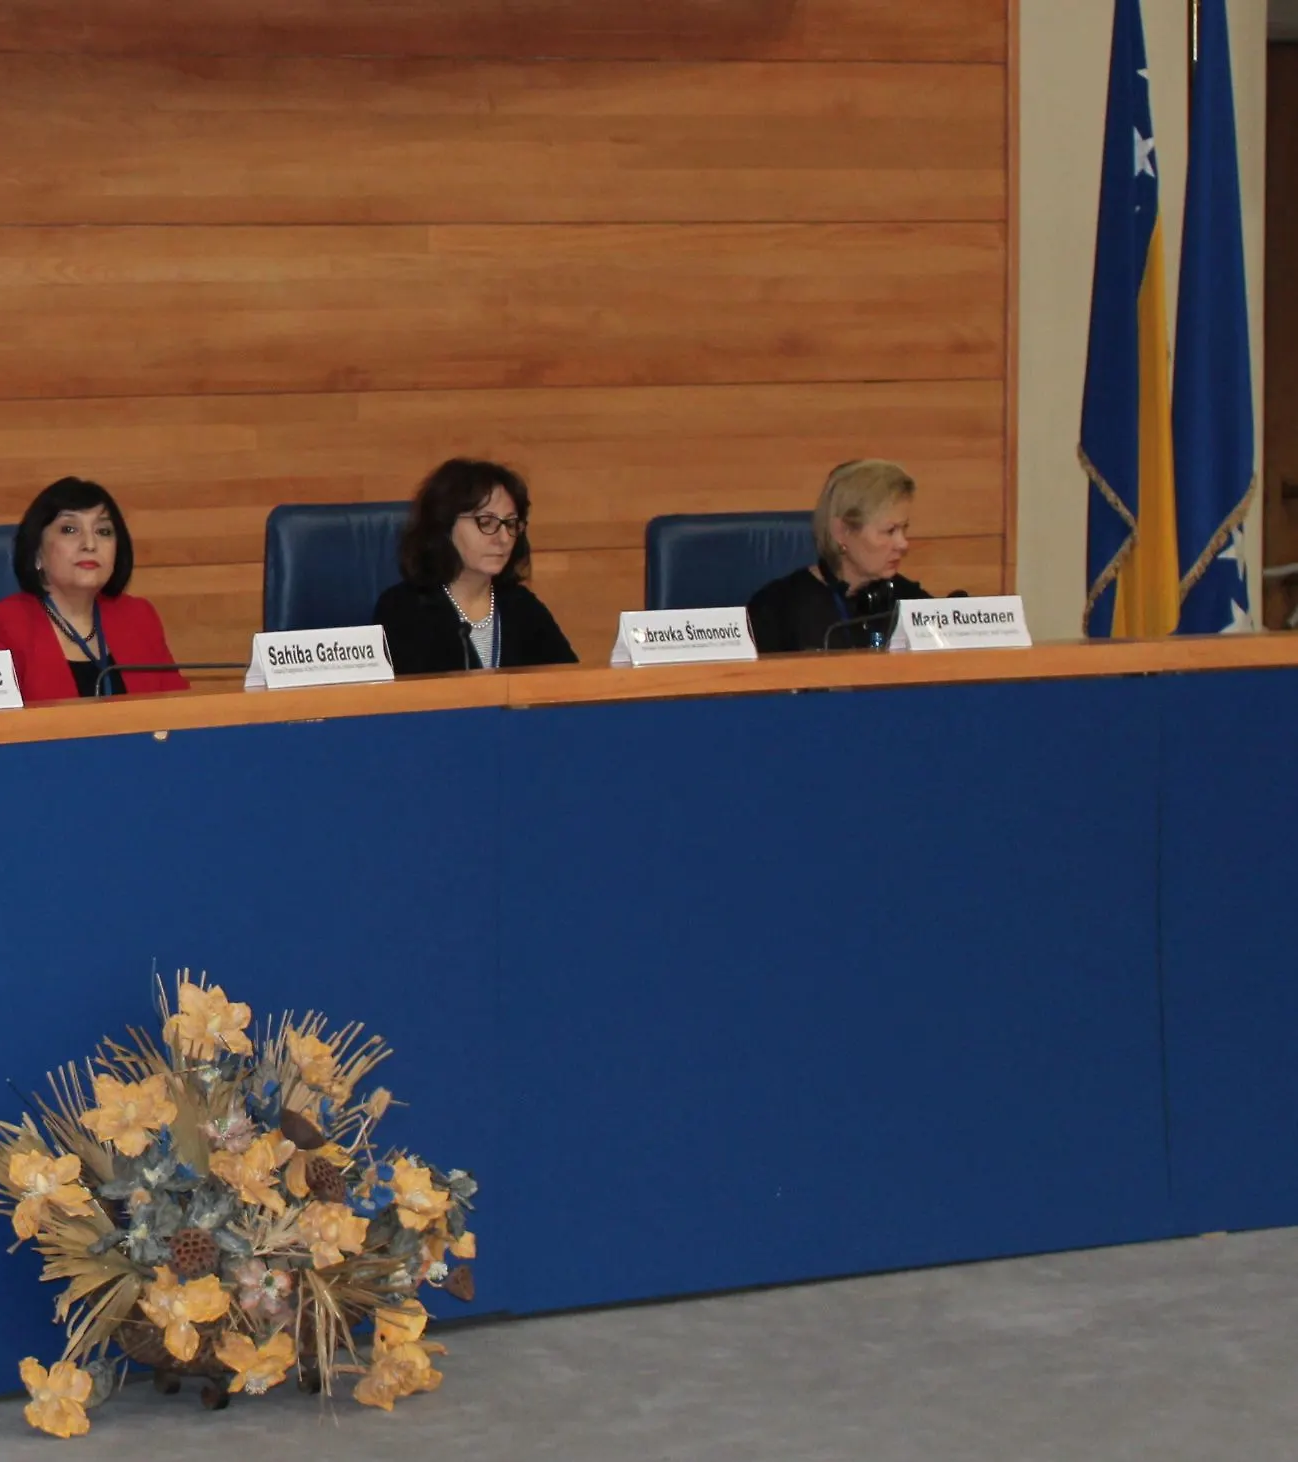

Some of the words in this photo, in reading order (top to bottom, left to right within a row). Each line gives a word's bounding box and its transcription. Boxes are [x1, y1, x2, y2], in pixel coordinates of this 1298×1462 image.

[952, 610, 1014, 625] Ruotanen
[685, 620, 741, 641] Šimonović
[268, 645, 314, 666] Sahiba
[316, 642, 375, 662] Gafarova
